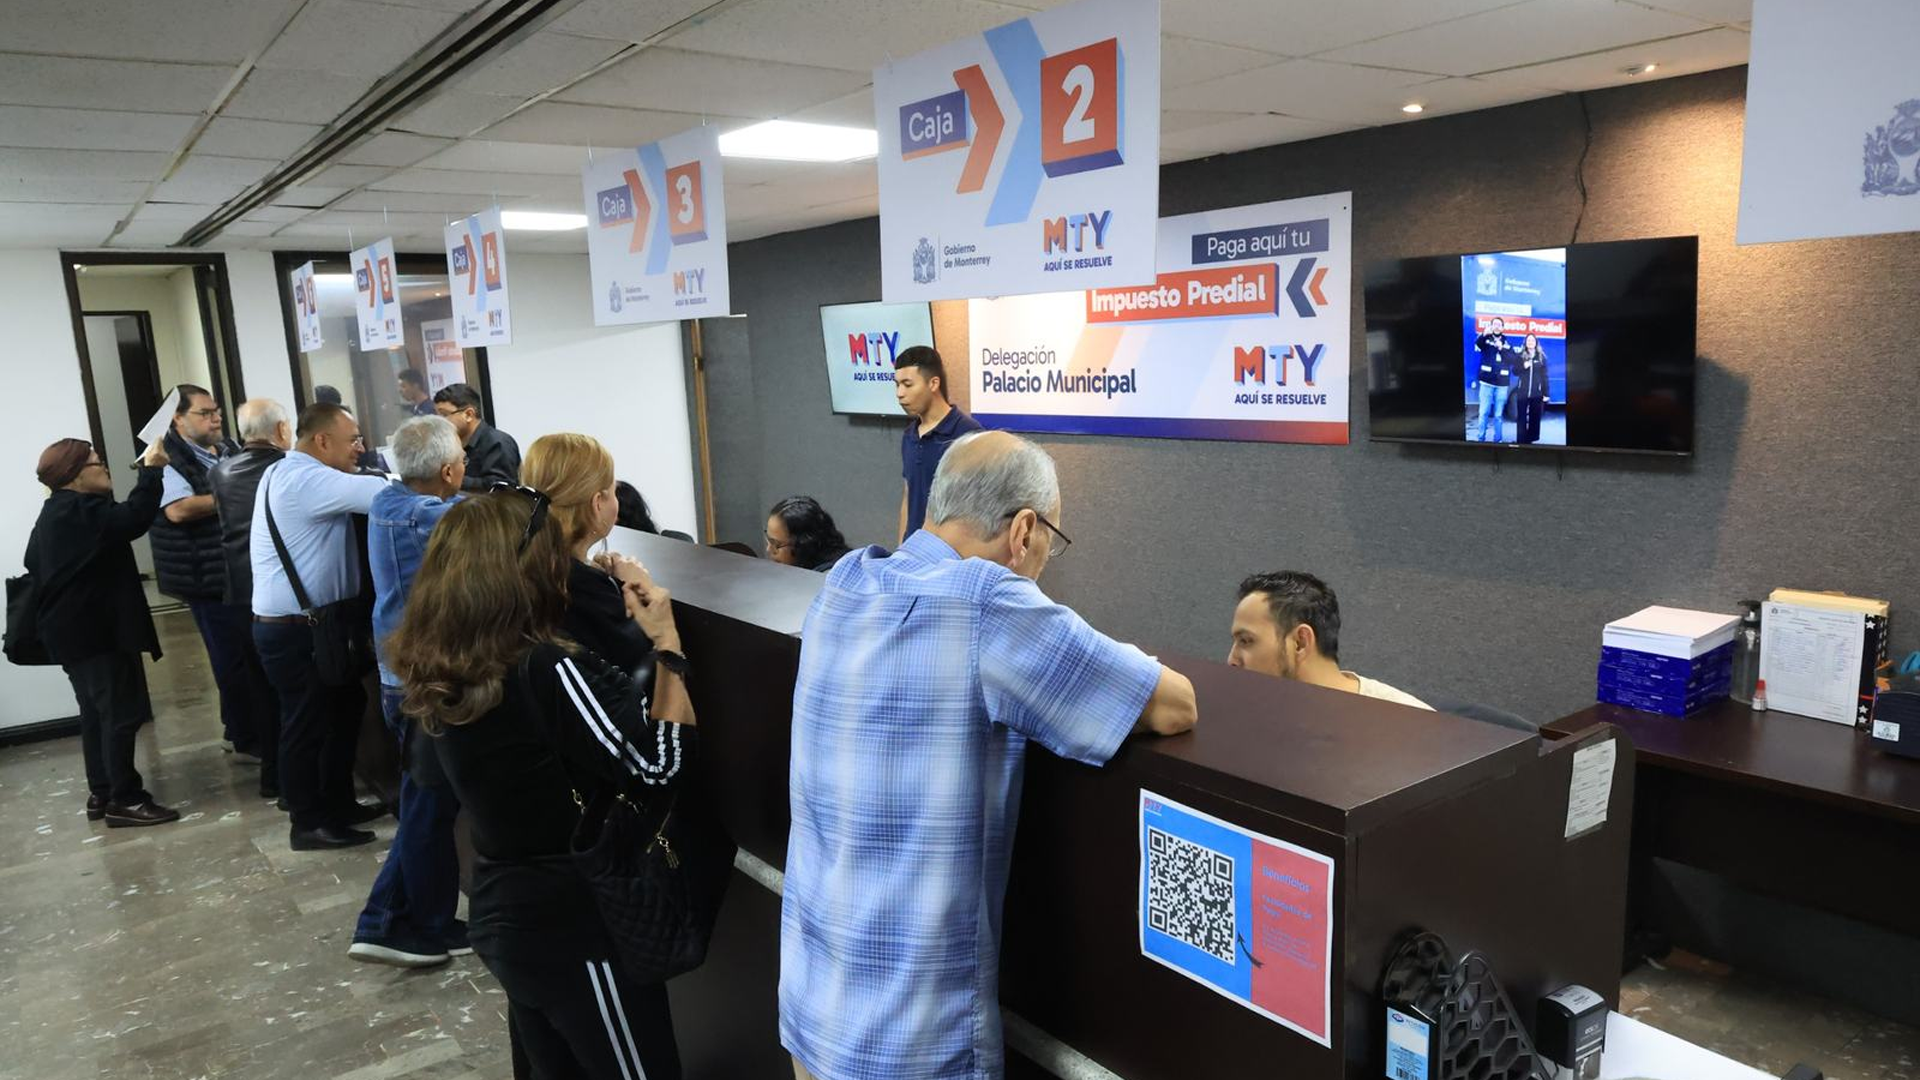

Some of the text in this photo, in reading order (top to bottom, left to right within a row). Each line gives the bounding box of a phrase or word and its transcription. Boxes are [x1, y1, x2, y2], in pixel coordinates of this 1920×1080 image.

[1062, 64, 1096, 145] 2
[908, 105, 954, 145] Caja
[602, 194, 626, 219] Caja
[675, 174, 695, 224] 3
[1043, 210, 1113, 255] MTY
[1207, 226, 1311, 260] Paga aquí tu
[486, 241, 496, 276] 4
[944, 244, 976, 256] Gobierno
[954, 256, 991, 268] Monterrey
[1044, 256, 1113, 272] AQUÍ SE RESUELVE
[673, 267, 705, 295] MTY
[1091, 274, 1267, 317] Impuesto Predial
[848, 331, 899, 367] MTY
[982, 344, 1057, 370] Delegación
[1234, 344, 1326, 386] MTY
[982, 367, 1137, 399] Palacio Municipal
[1234, 390, 1327, 405] AQUÍ SE RESUELVE
